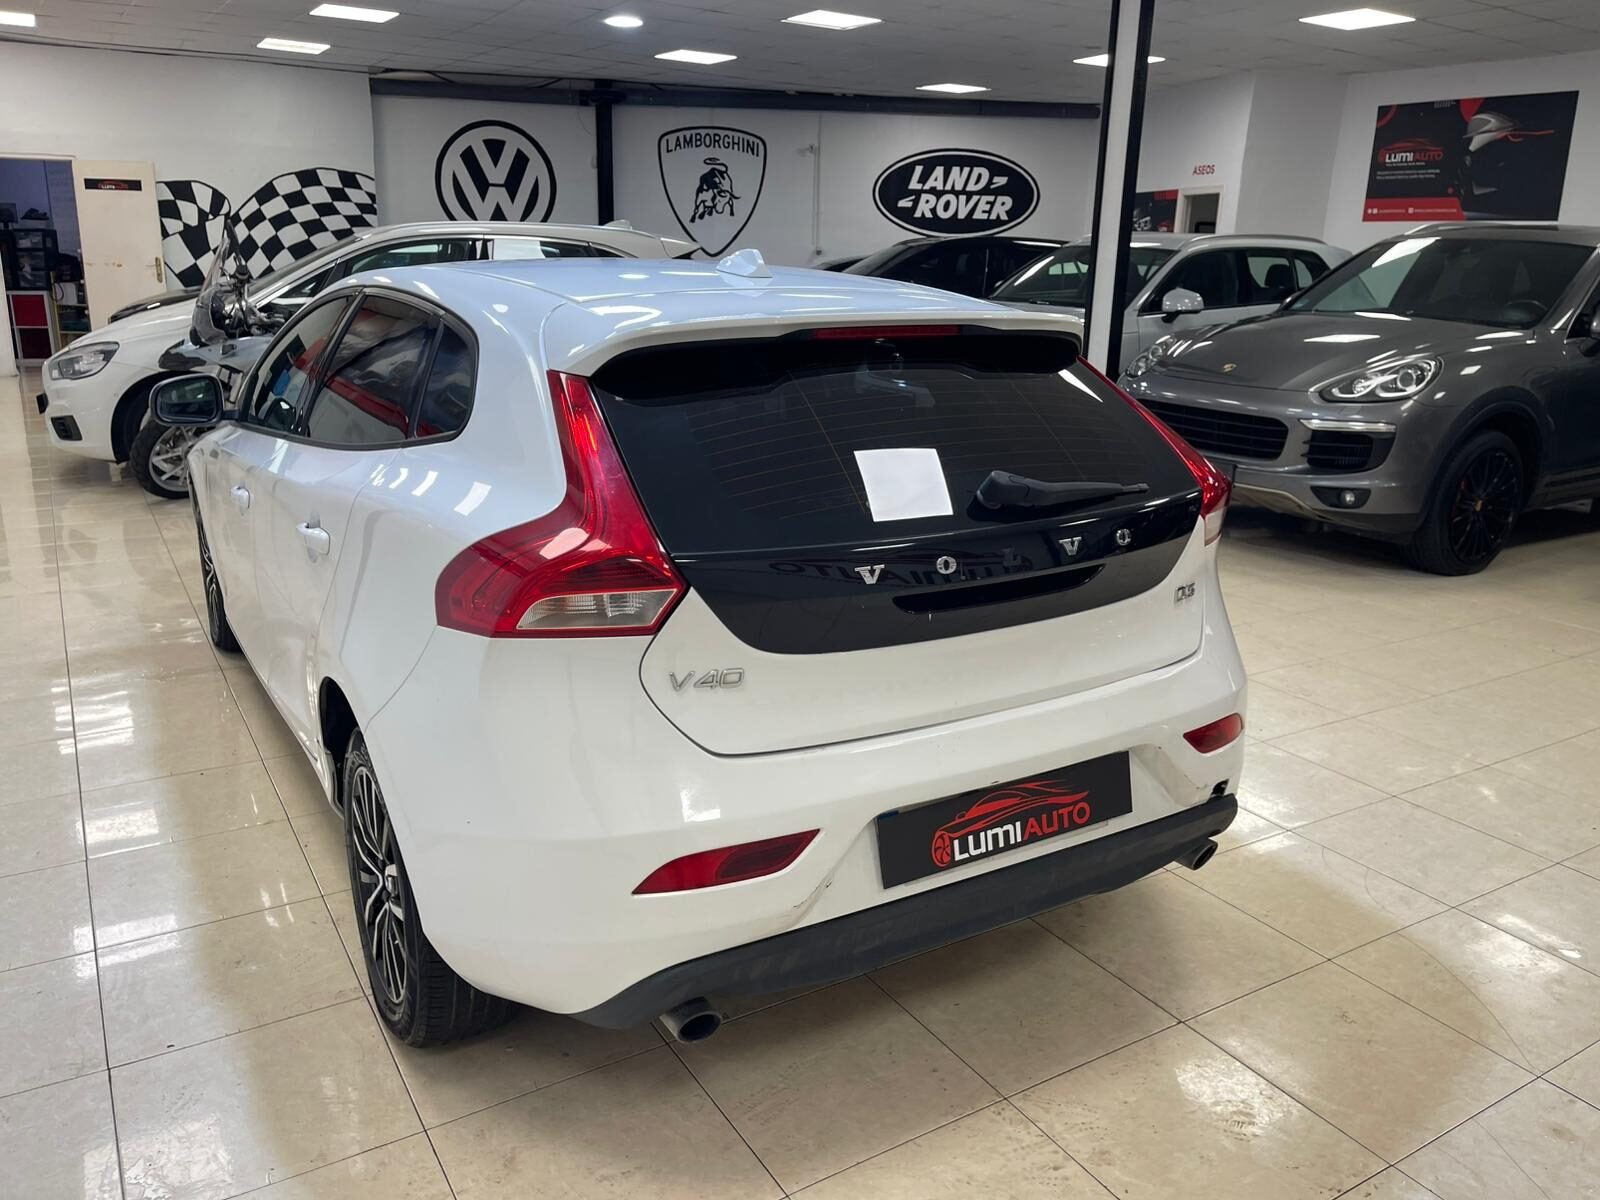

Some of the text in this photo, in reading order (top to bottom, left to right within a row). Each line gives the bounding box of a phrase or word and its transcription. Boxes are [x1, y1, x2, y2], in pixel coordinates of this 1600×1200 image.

[665, 132, 761, 158] LAMBORGHINI
[908, 165, 990, 191] LAND
[1192, 164, 1216, 176] ASEOS
[913, 193, 1013, 221] ROVER
[668, 667, 745, 692] V40
[953, 801, 1091, 862] LUMIAUTO
